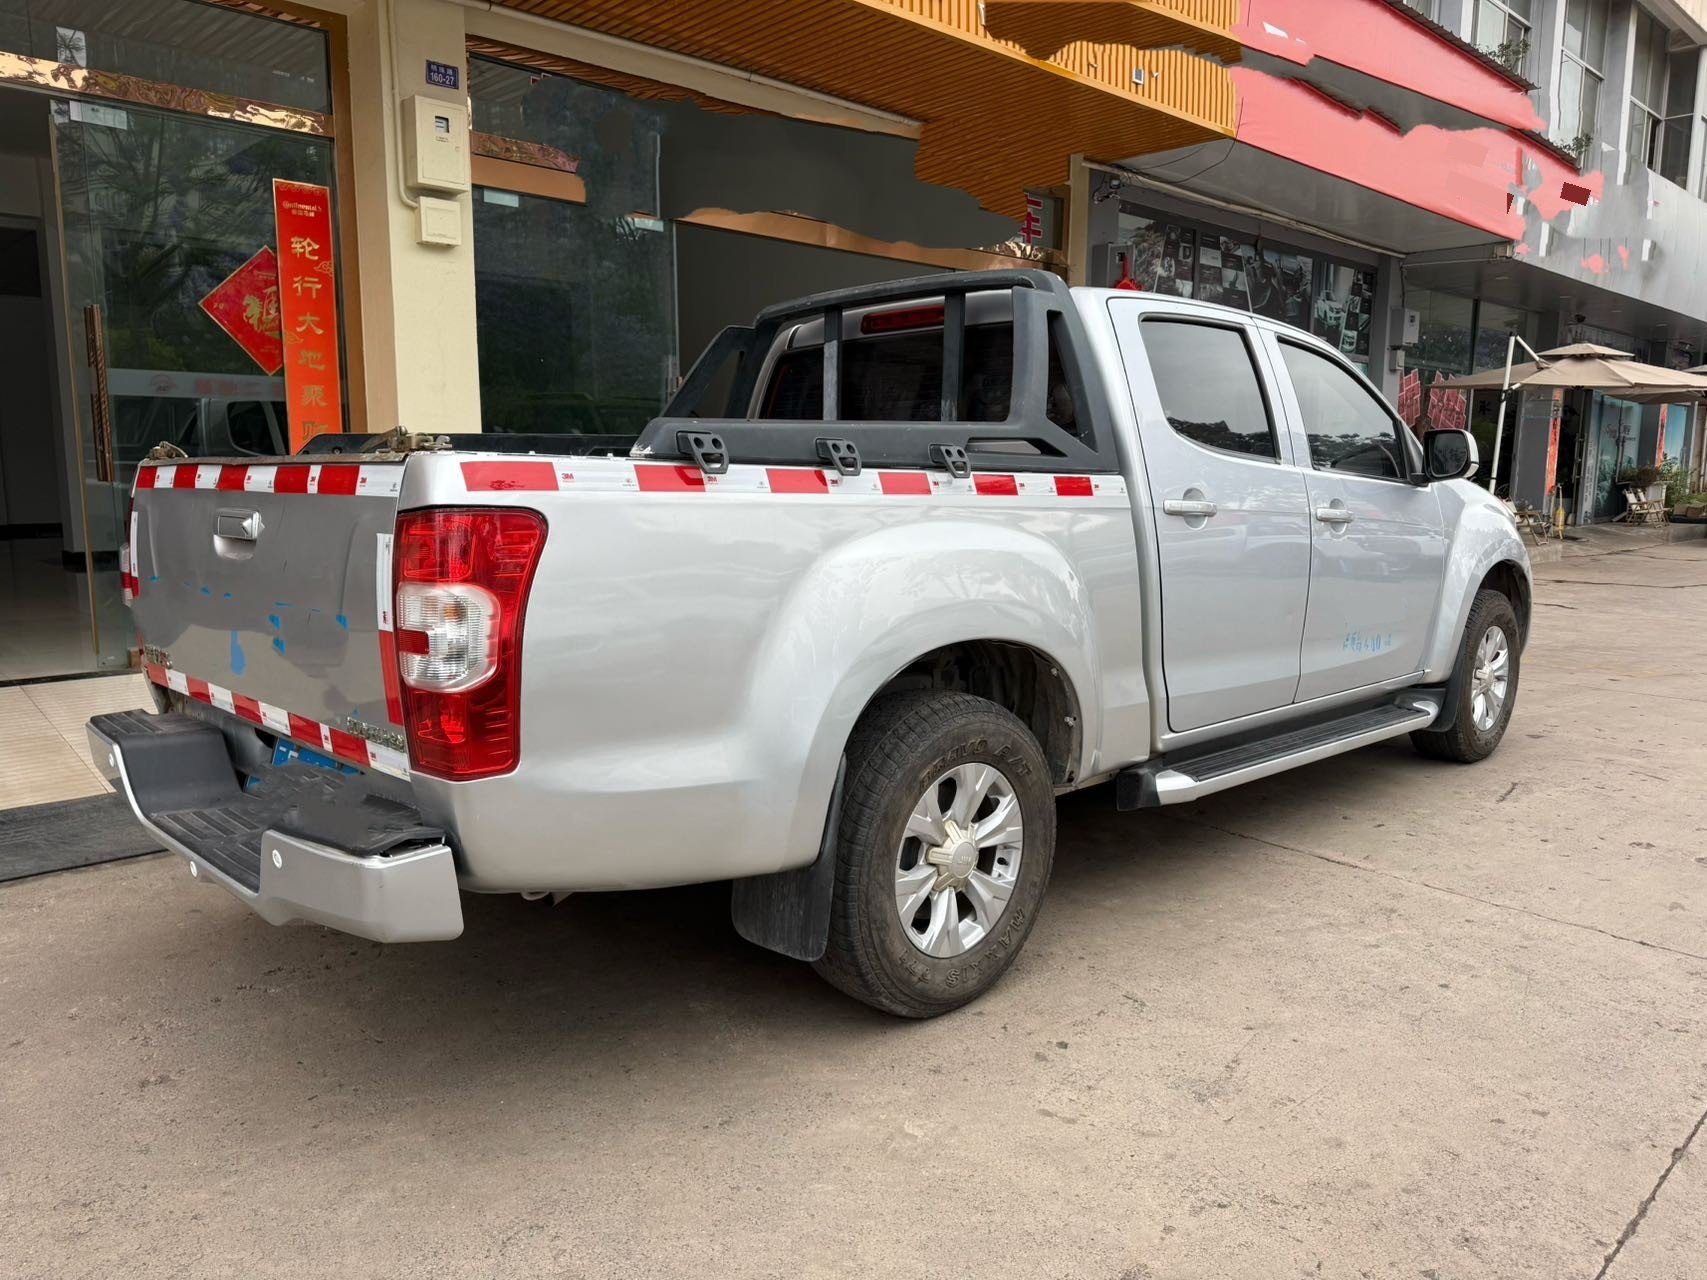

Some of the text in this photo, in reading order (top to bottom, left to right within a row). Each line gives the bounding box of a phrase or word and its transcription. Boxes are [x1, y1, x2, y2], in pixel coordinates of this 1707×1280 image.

[430, 72, 454, 85] 160-27
[561, 472, 574, 480] 3M
[919, 736, 988, 792] BRAVO
[945, 907, 1026, 989] MAXXIS
